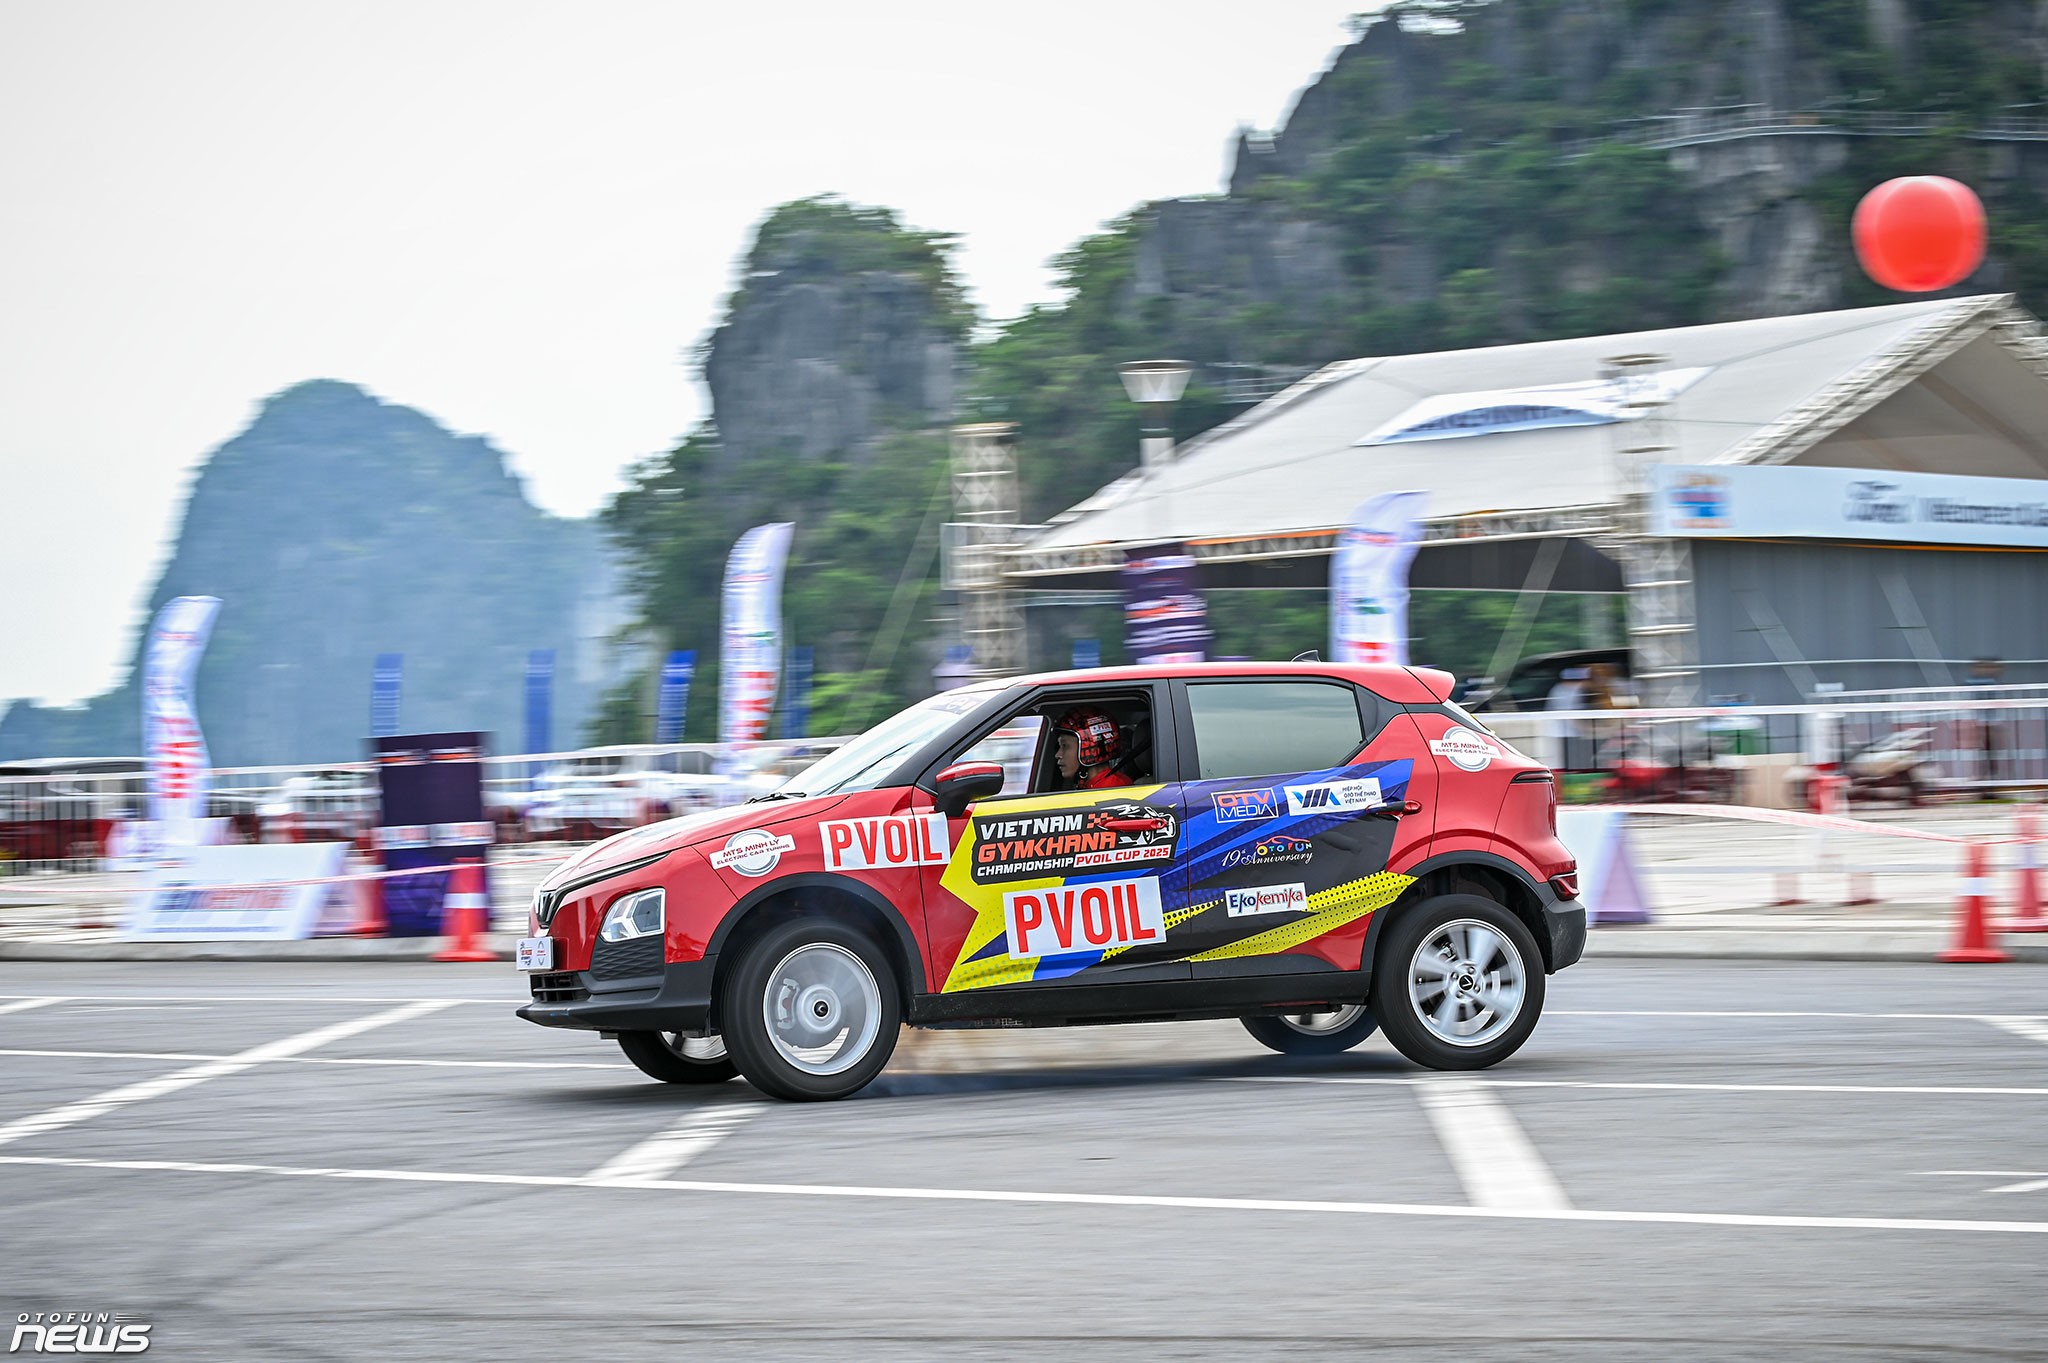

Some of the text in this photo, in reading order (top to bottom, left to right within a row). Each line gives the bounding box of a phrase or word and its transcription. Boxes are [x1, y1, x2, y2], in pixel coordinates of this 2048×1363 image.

[1217, 792, 1271, 807] OTV
[1220, 803, 1276, 819] MEDIA
[980, 814, 1084, 841] VIETNAM
[716, 843, 791, 865] ELECTRIC CAR TUNING
[722, 847, 744, 858] MTS
[745, 842, 768, 853] MINH
[827, 817, 943, 867] PVOIL
[978, 831, 1117, 864] GYMKHANA
[977, 847, 1170, 877] CHAMPIONSHIP PVOIL CUP 2025
[1241, 851, 1313, 866] Anniversary
[1229, 887, 1304, 914] Ekokemika
[1013, 883, 1156, 954] PVOIL
